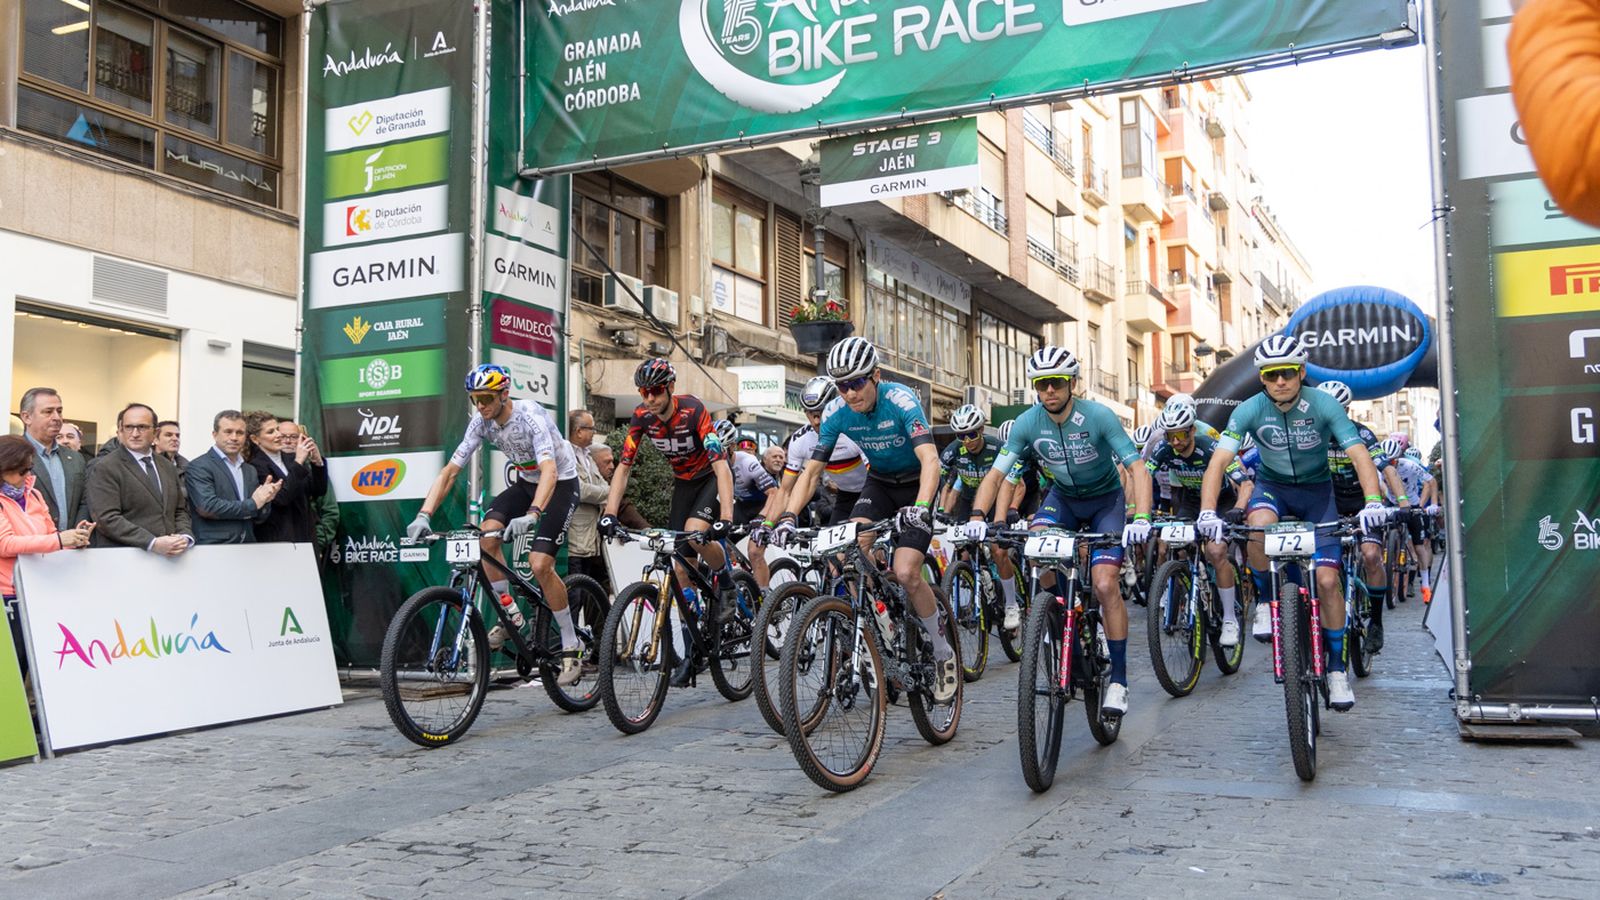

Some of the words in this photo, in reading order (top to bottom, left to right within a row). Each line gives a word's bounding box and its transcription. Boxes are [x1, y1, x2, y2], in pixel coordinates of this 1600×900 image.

[564, 31, 642, 62] GRANADA
[721, 33, 750, 45] YEARS
[768, 13, 878, 77] BIKE
[894, 0, 1042, 56] RACE
[323, 42, 405, 78] Andalucía
[564, 60, 606, 87] JAÉN
[564, 82, 641, 113] CÓRDOBA
[376, 109, 424, 125] Diputación
[375, 126, 387, 135] de
[388, 118, 426, 132] Granada
[853, 134, 920, 156] STAGE
[927, 131, 941, 146] 3
[167, 149, 273, 192] MURIANA
[879, 153, 915, 172] JAÉN
[870, 178, 927, 194] GARMIN
[375, 203, 422, 220] Diputación
[374, 221, 386, 230] de
[387, 215, 422, 227] Córdoba
[333, 255, 436, 287] GARMIN
[494, 257, 556, 289] GARMIN
[395, 318, 424, 330] RURAL
[513, 315, 553, 338] IMDECO
[387, 330, 409, 341] JAÉN
[1195, 398, 1243, 407] armin.com
[358, 415, 402, 436] NDL
[651, 436, 696, 452] BH
[1272, 435, 1295, 444] BIKE
[1049, 451, 1071, 459] BIKE
[828, 525, 847, 545] 1-2
[1170, 526, 1186, 538] 2-1
[1538, 515, 1563, 550] 15
[345, 534, 396, 551] Andalucía
[455, 542, 470, 558] 9-1
[1039, 537, 1060, 553] 7-1
[1278, 535, 1303, 552] 7-2
[345, 551, 368, 563] BIKE
[370, 550, 398, 562] RACE
[53, 612, 231, 670] Andalucía
[268, 640, 284, 648] Junta
[293, 634, 321, 644] Andalucía
